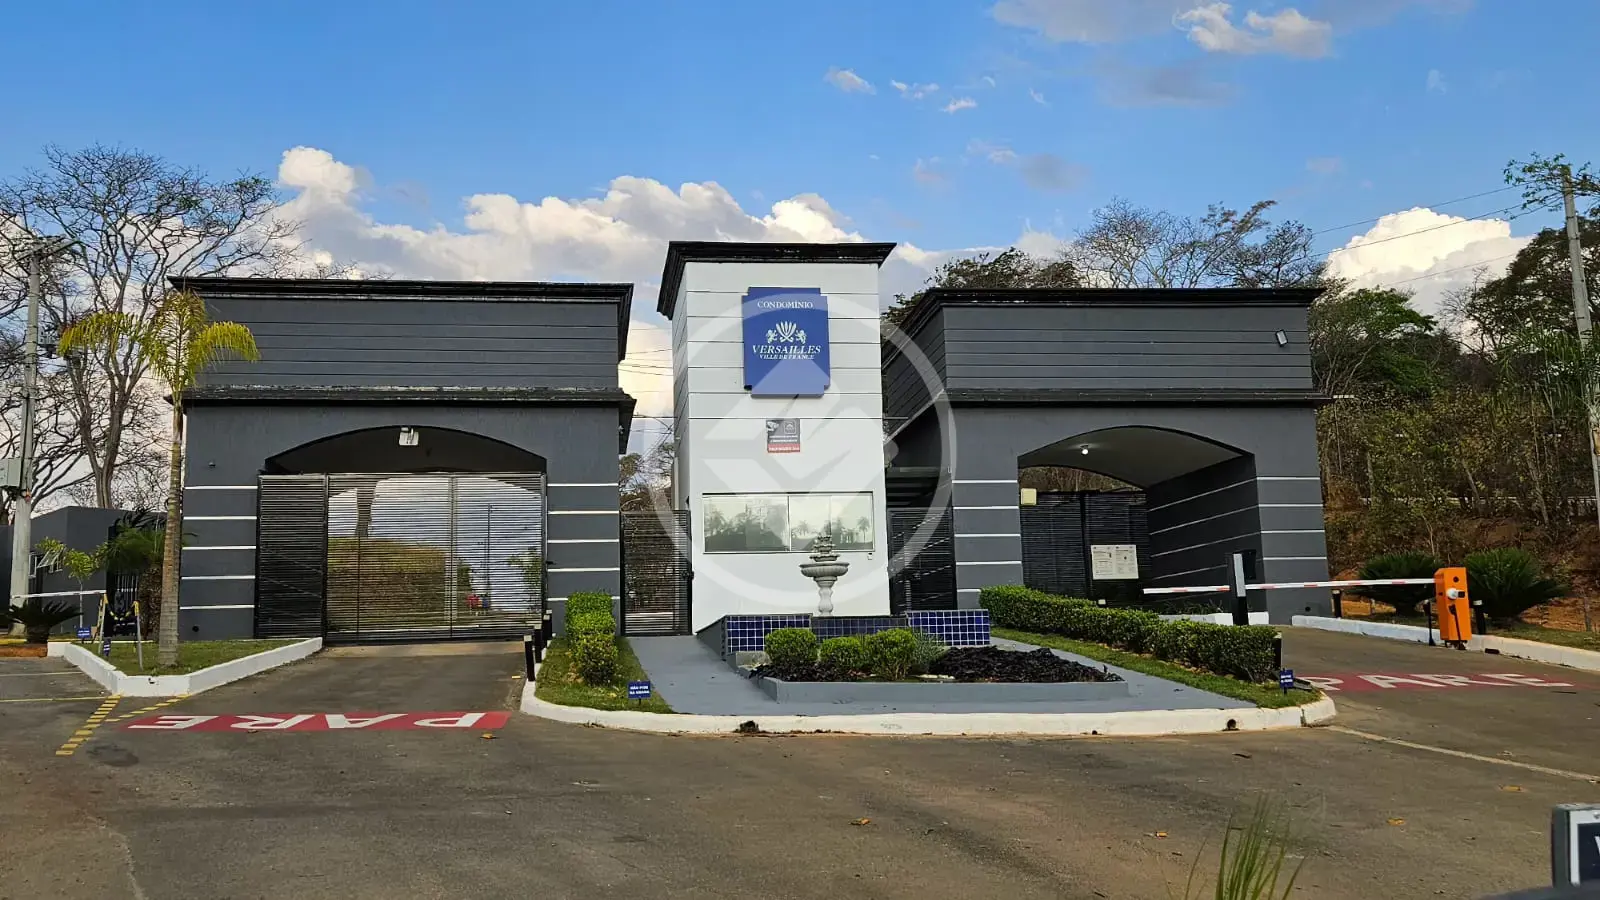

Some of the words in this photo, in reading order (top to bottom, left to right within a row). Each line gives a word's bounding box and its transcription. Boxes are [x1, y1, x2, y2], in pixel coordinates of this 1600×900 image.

[752, 345, 821, 354] VERSAILLES
[1294, 673, 1575, 691] PARE
[128, 713, 486, 730] PARE
